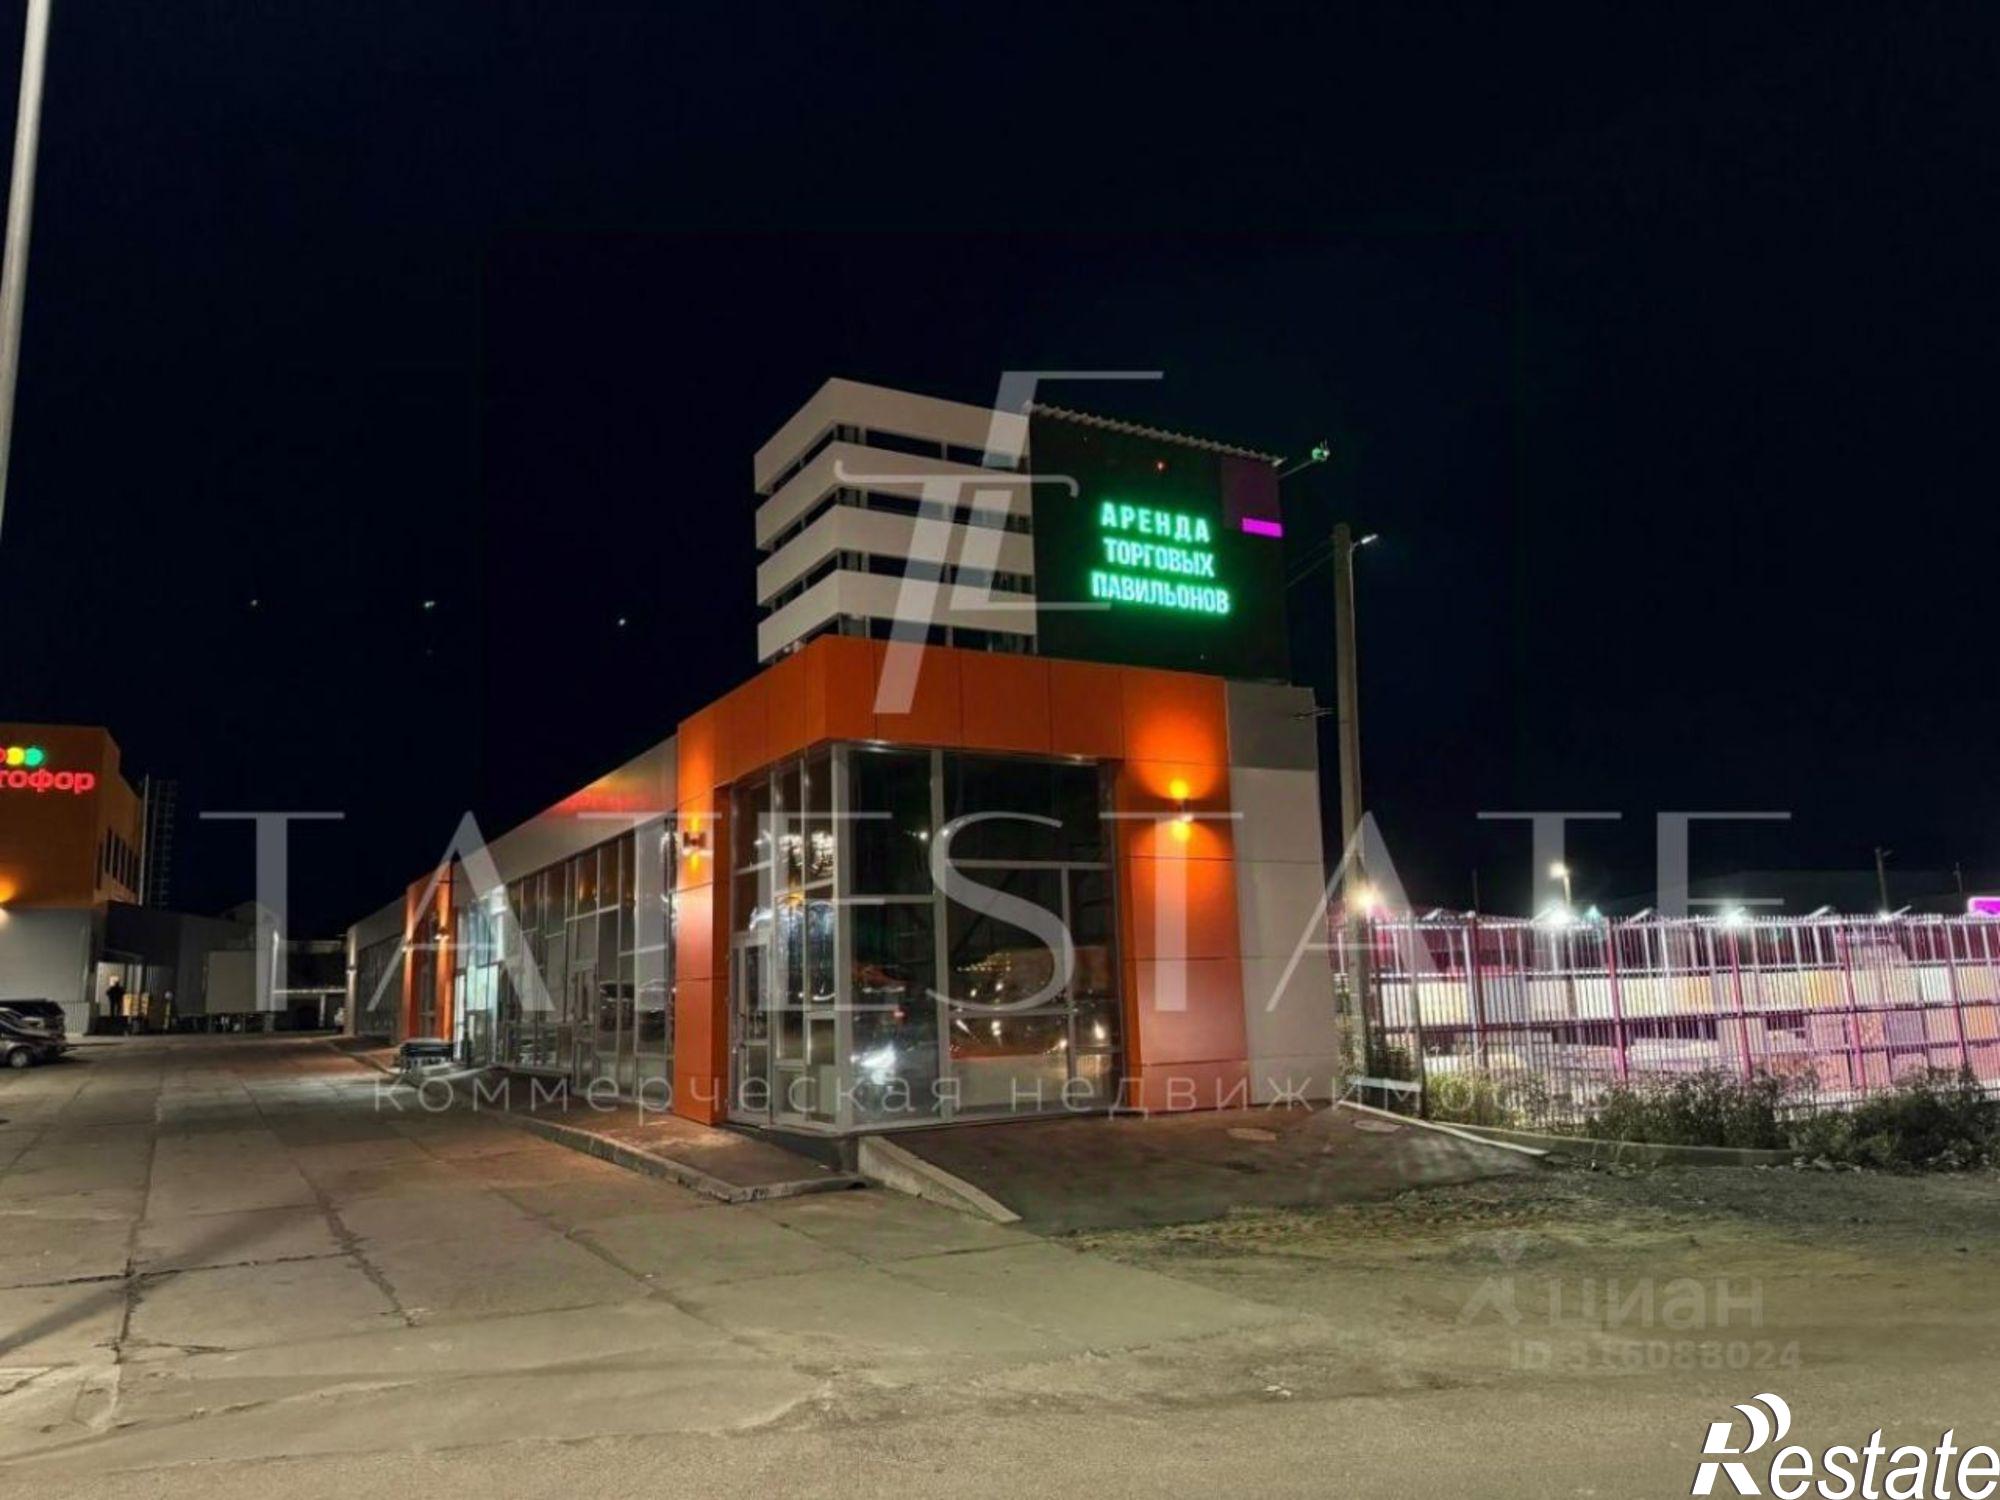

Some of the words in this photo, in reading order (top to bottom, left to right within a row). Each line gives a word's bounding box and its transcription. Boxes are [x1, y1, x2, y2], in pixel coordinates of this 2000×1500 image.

[1101, 501, 1211, 543] АРЕНДА
[1102, 537, 1216, 578] ТОРГОВЫХ
[1090, 570, 1231, 615] ПАВИЛЬОНОВ
